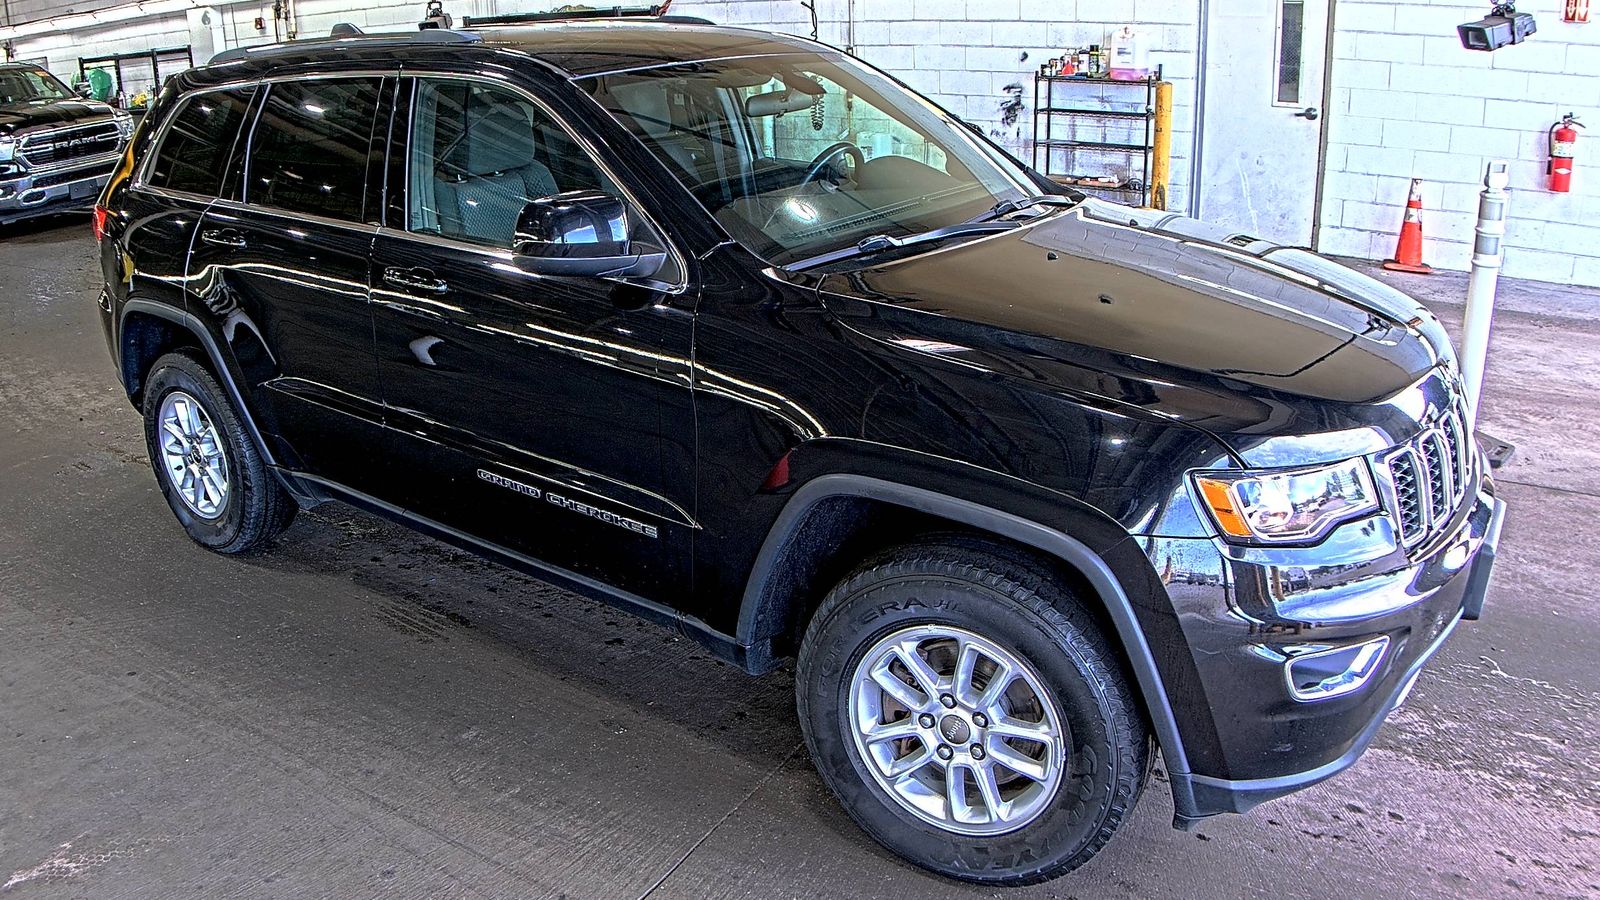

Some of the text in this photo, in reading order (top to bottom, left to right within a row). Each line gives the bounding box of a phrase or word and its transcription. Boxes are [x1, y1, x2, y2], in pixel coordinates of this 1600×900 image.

[55, 136, 96, 149] RAM
[476, 468, 658, 539] GRAND CHEROKEE
